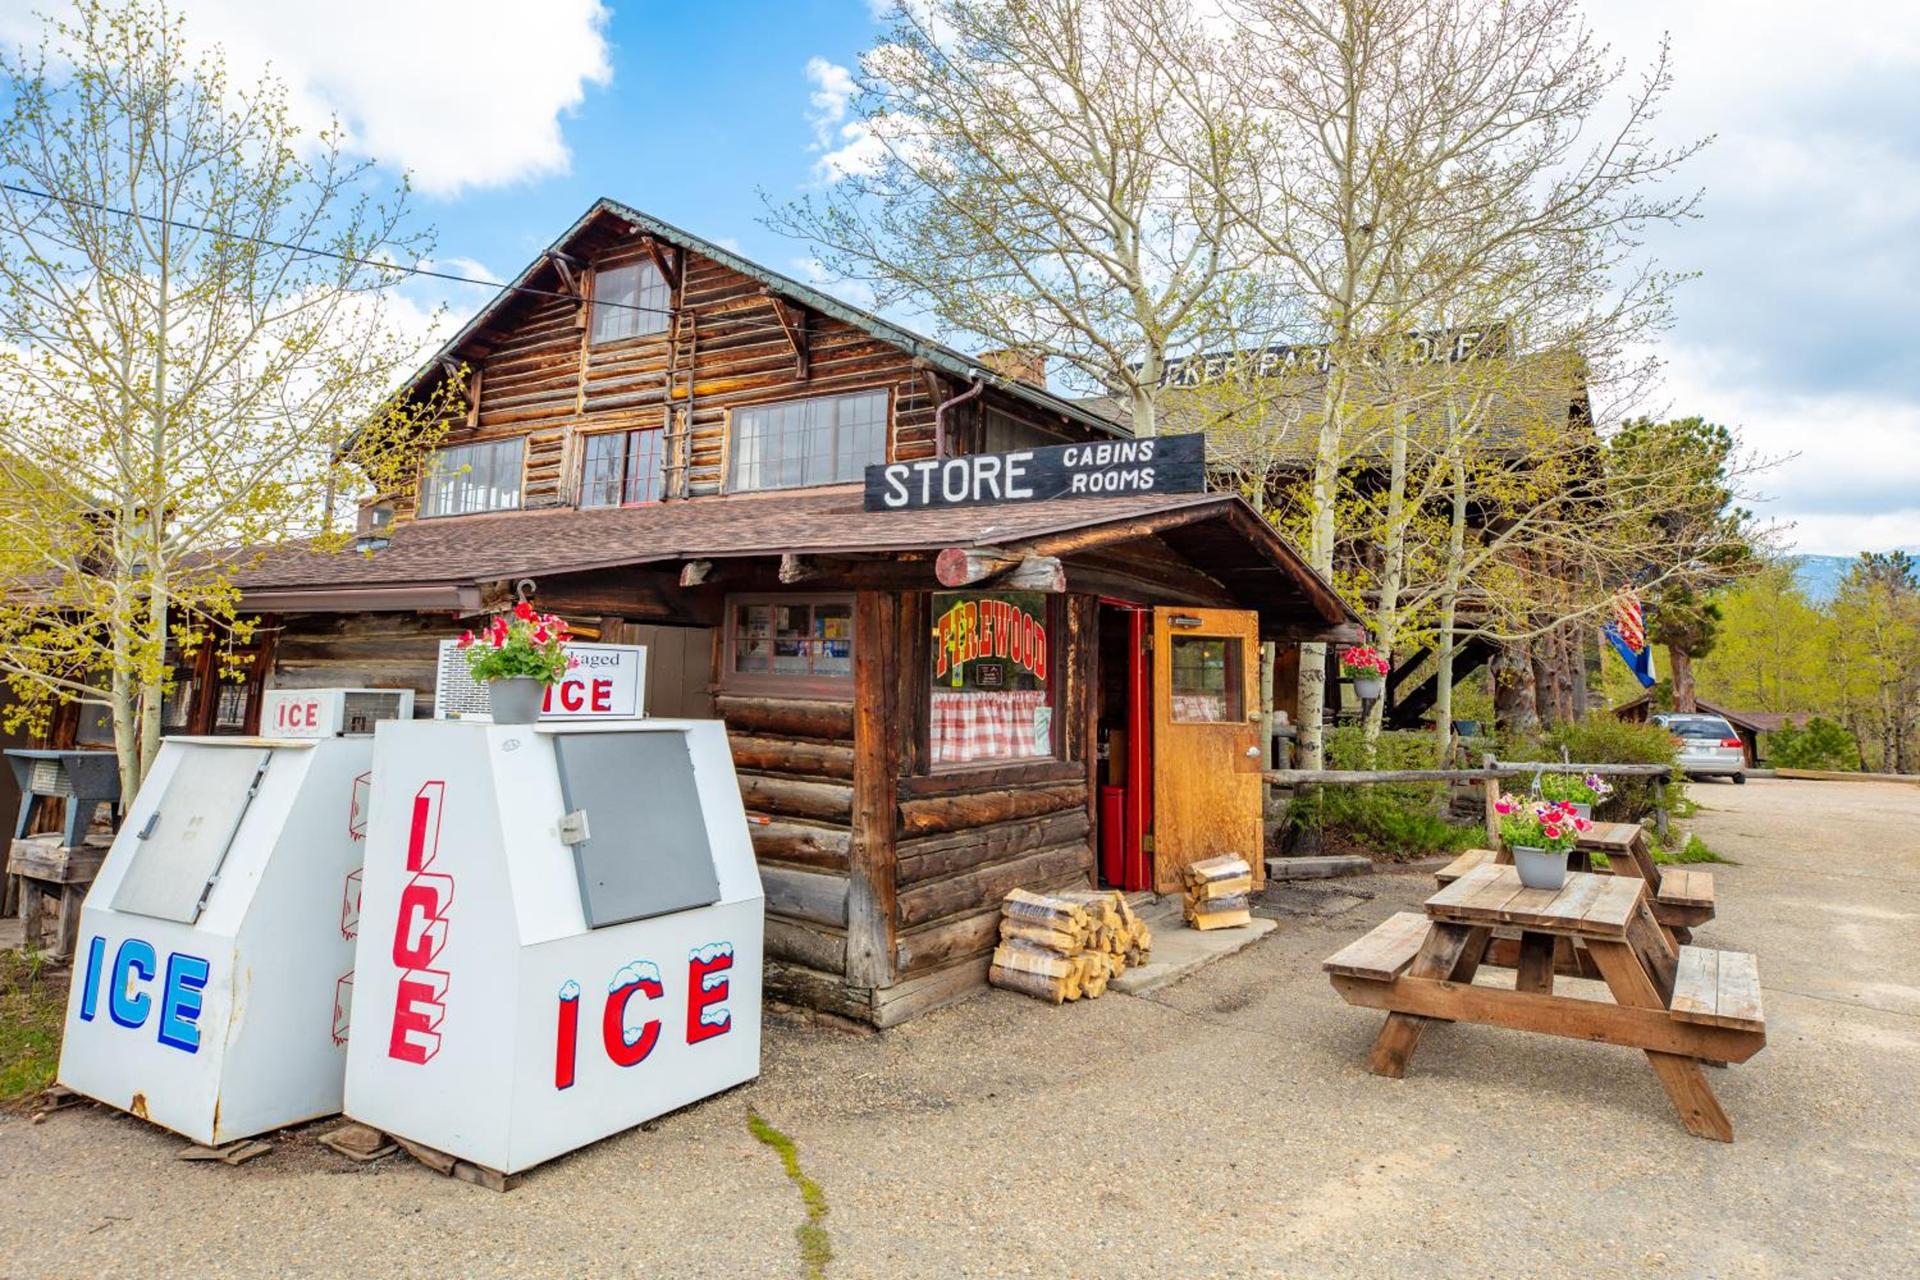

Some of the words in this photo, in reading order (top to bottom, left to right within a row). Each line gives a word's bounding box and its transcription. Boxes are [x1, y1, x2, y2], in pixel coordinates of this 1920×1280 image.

[883, 452, 1034, 508] STORE
[1063, 440, 1155, 467] CABINS
[1071, 467, 1156, 494] ROOMS
[937, 599, 1046, 680] FIREWOOD
[278, 703, 318, 728] ICE
[541, 676, 613, 713] ICE
[388, 780, 454, 1066] ICE
[80, 935, 211, 1054] ICE
[555, 941, 734, 1091] ICE
